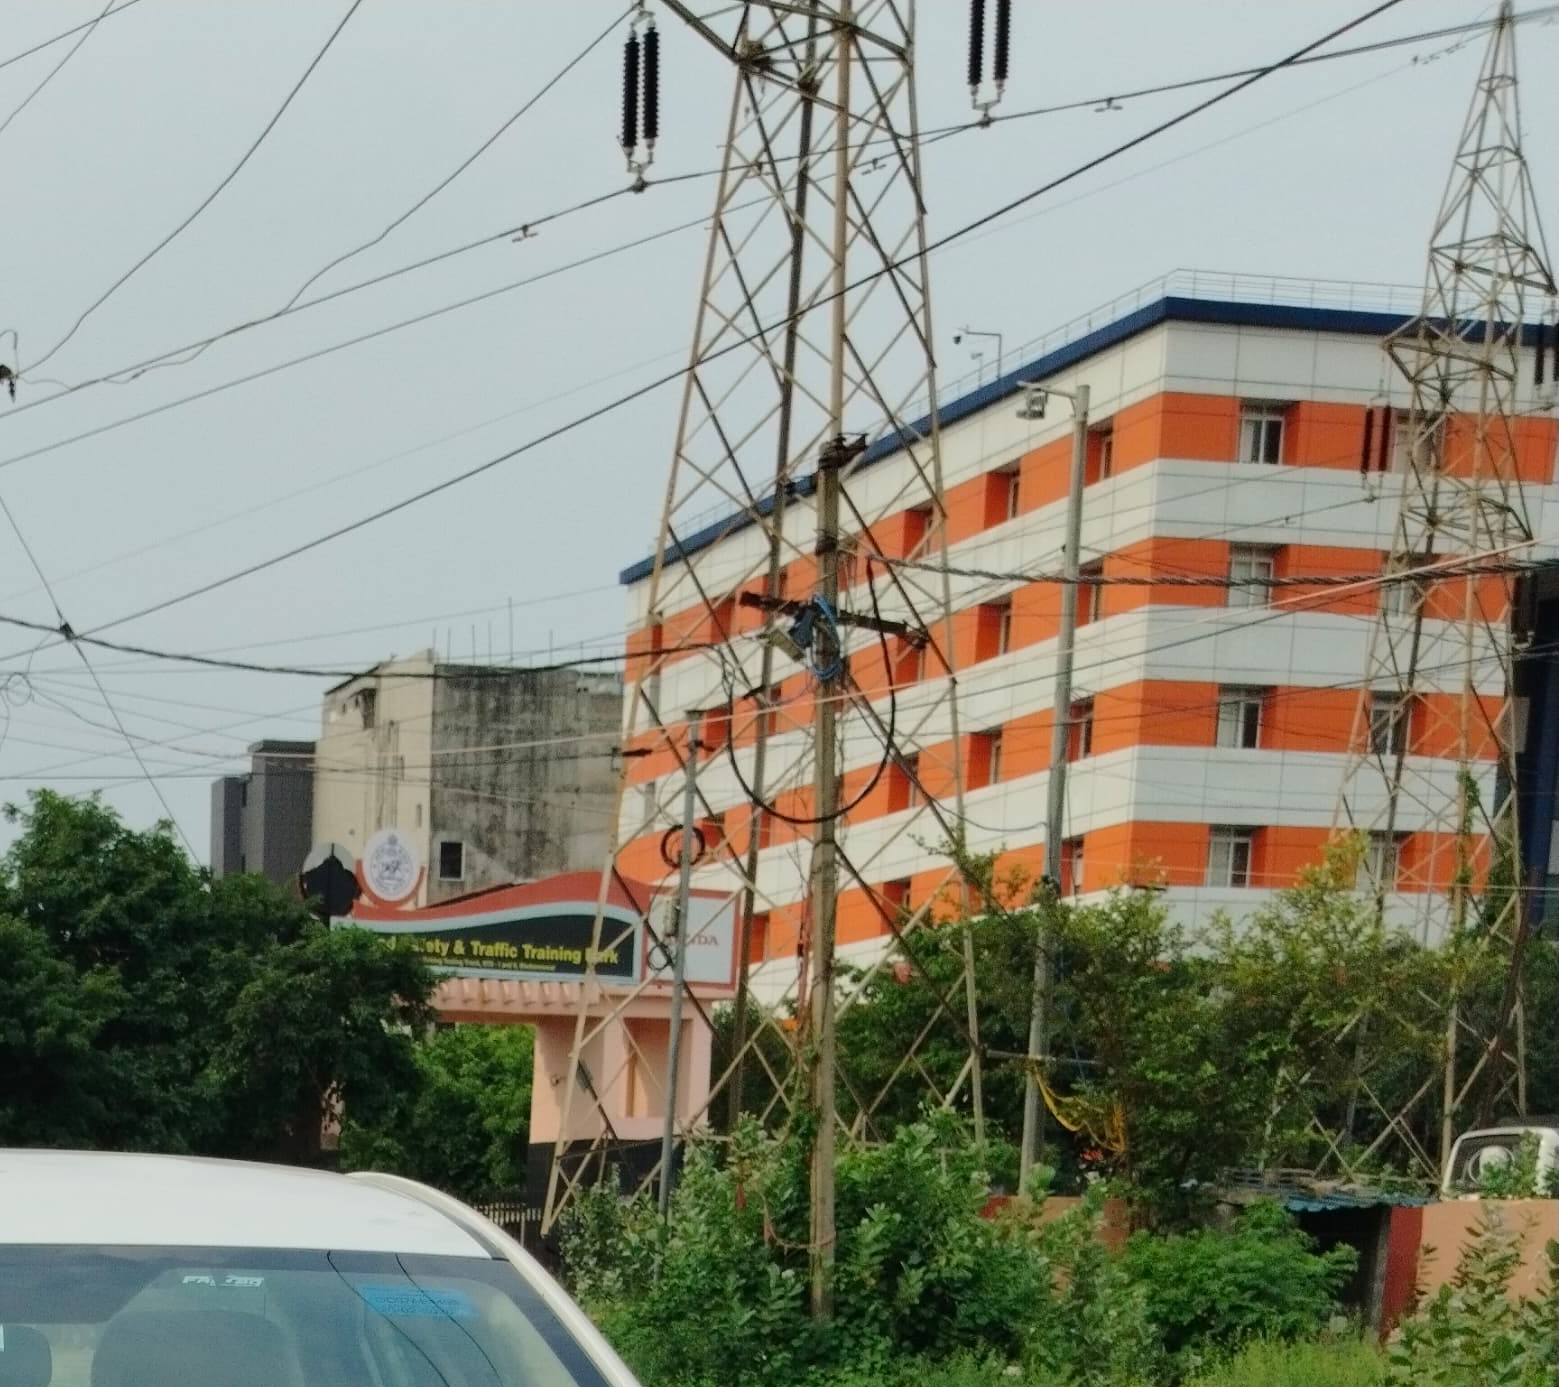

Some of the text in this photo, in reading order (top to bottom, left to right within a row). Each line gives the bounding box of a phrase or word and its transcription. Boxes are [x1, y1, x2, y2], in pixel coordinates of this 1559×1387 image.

[453, 939, 465, 955] &
[470, 940, 519, 959] Traffic
[522, 943, 582, 964] Training
[585, 947, 619, 964] Prk
